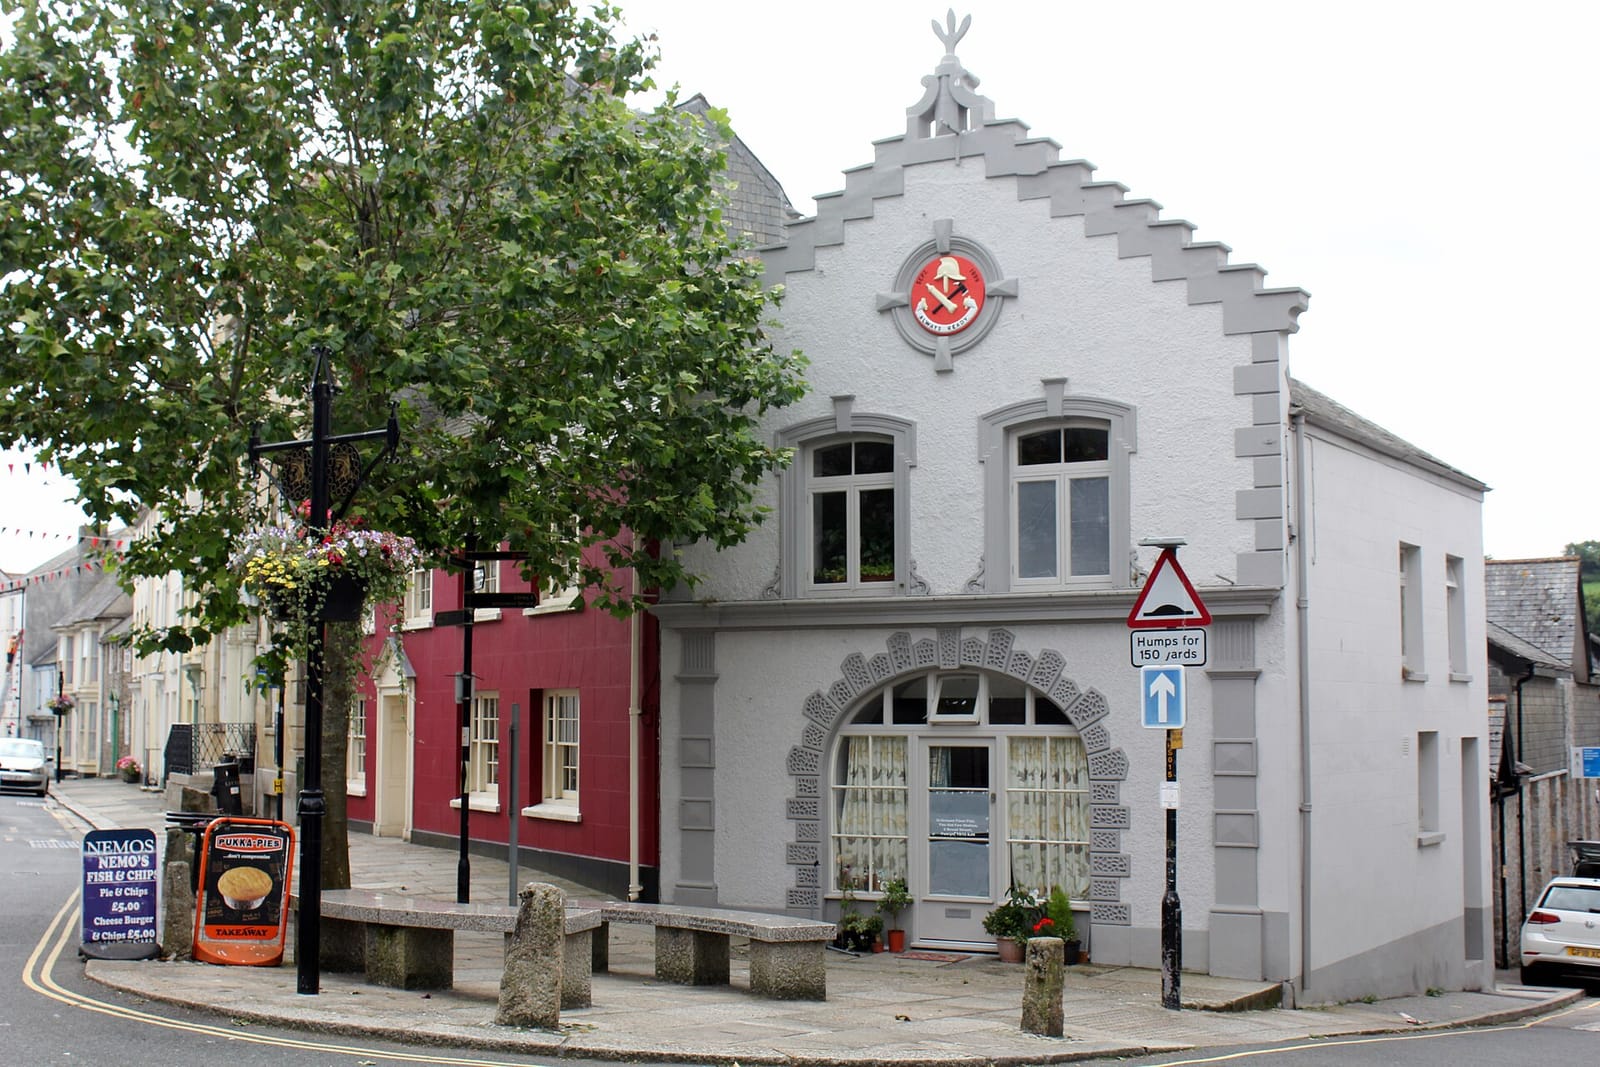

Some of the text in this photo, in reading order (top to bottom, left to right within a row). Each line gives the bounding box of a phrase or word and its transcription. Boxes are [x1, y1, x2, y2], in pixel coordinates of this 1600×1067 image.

[1137, 635, 1200, 650] Humps for
[1139, 650, 1160, 660] 150
[86, 839, 154, 855] NEMOS
[98, 855, 150, 869] NEMO'S
[87, 871, 114, 882] FISH
[115, 870, 125, 881] &
[99, 887, 149, 897] Pie & Chips
[111, 901, 140, 913] £5.00
[93, 915, 154, 926] Cheese Burger
[92, 932, 100, 941] &
[101, 931, 126, 941] Chips
[127, 929, 156, 940] £5.00
[215, 926, 269, 937] TAKEAWAY
